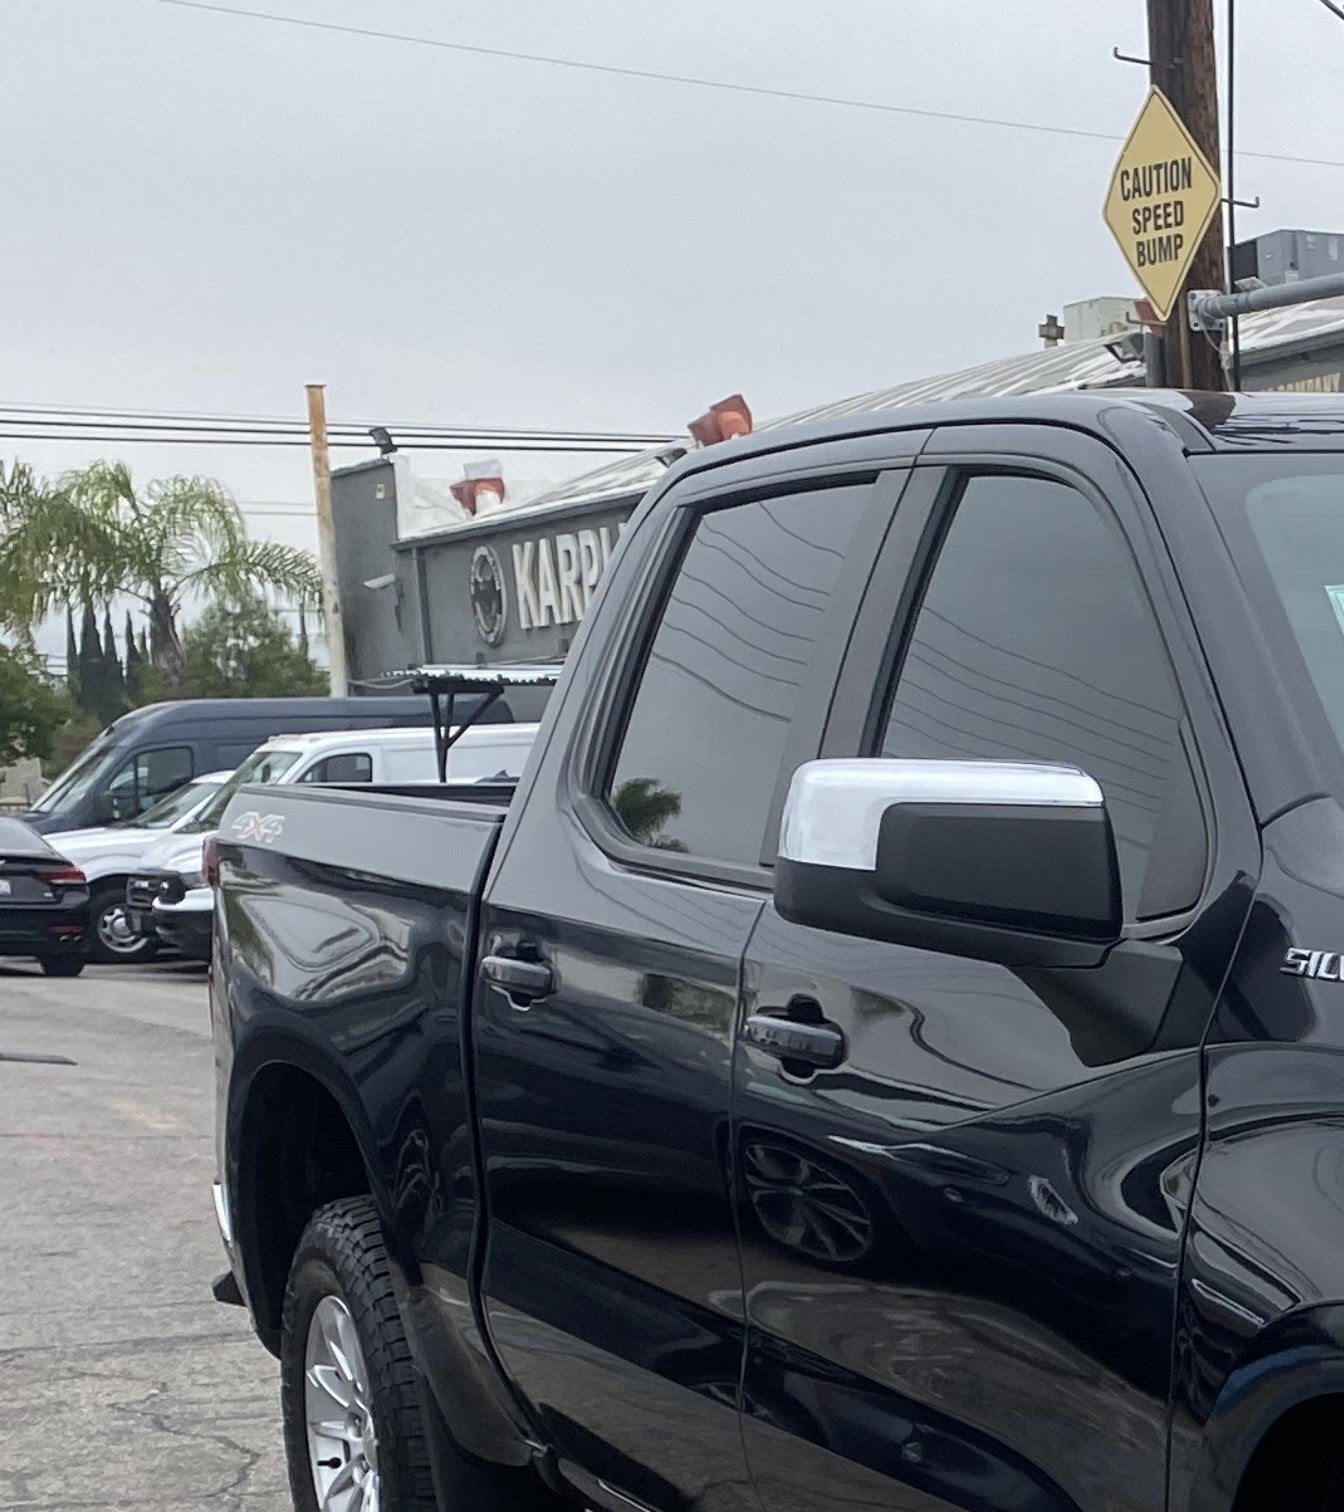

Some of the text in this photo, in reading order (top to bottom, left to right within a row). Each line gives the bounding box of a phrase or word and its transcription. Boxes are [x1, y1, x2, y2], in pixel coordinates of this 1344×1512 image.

[1120, 156, 1192, 201] CAUTION
[1131, 200, 1184, 235] SPEED
[1135, 233, 1184, 268] BUMP
[512, 522, 627, 630] KARP
